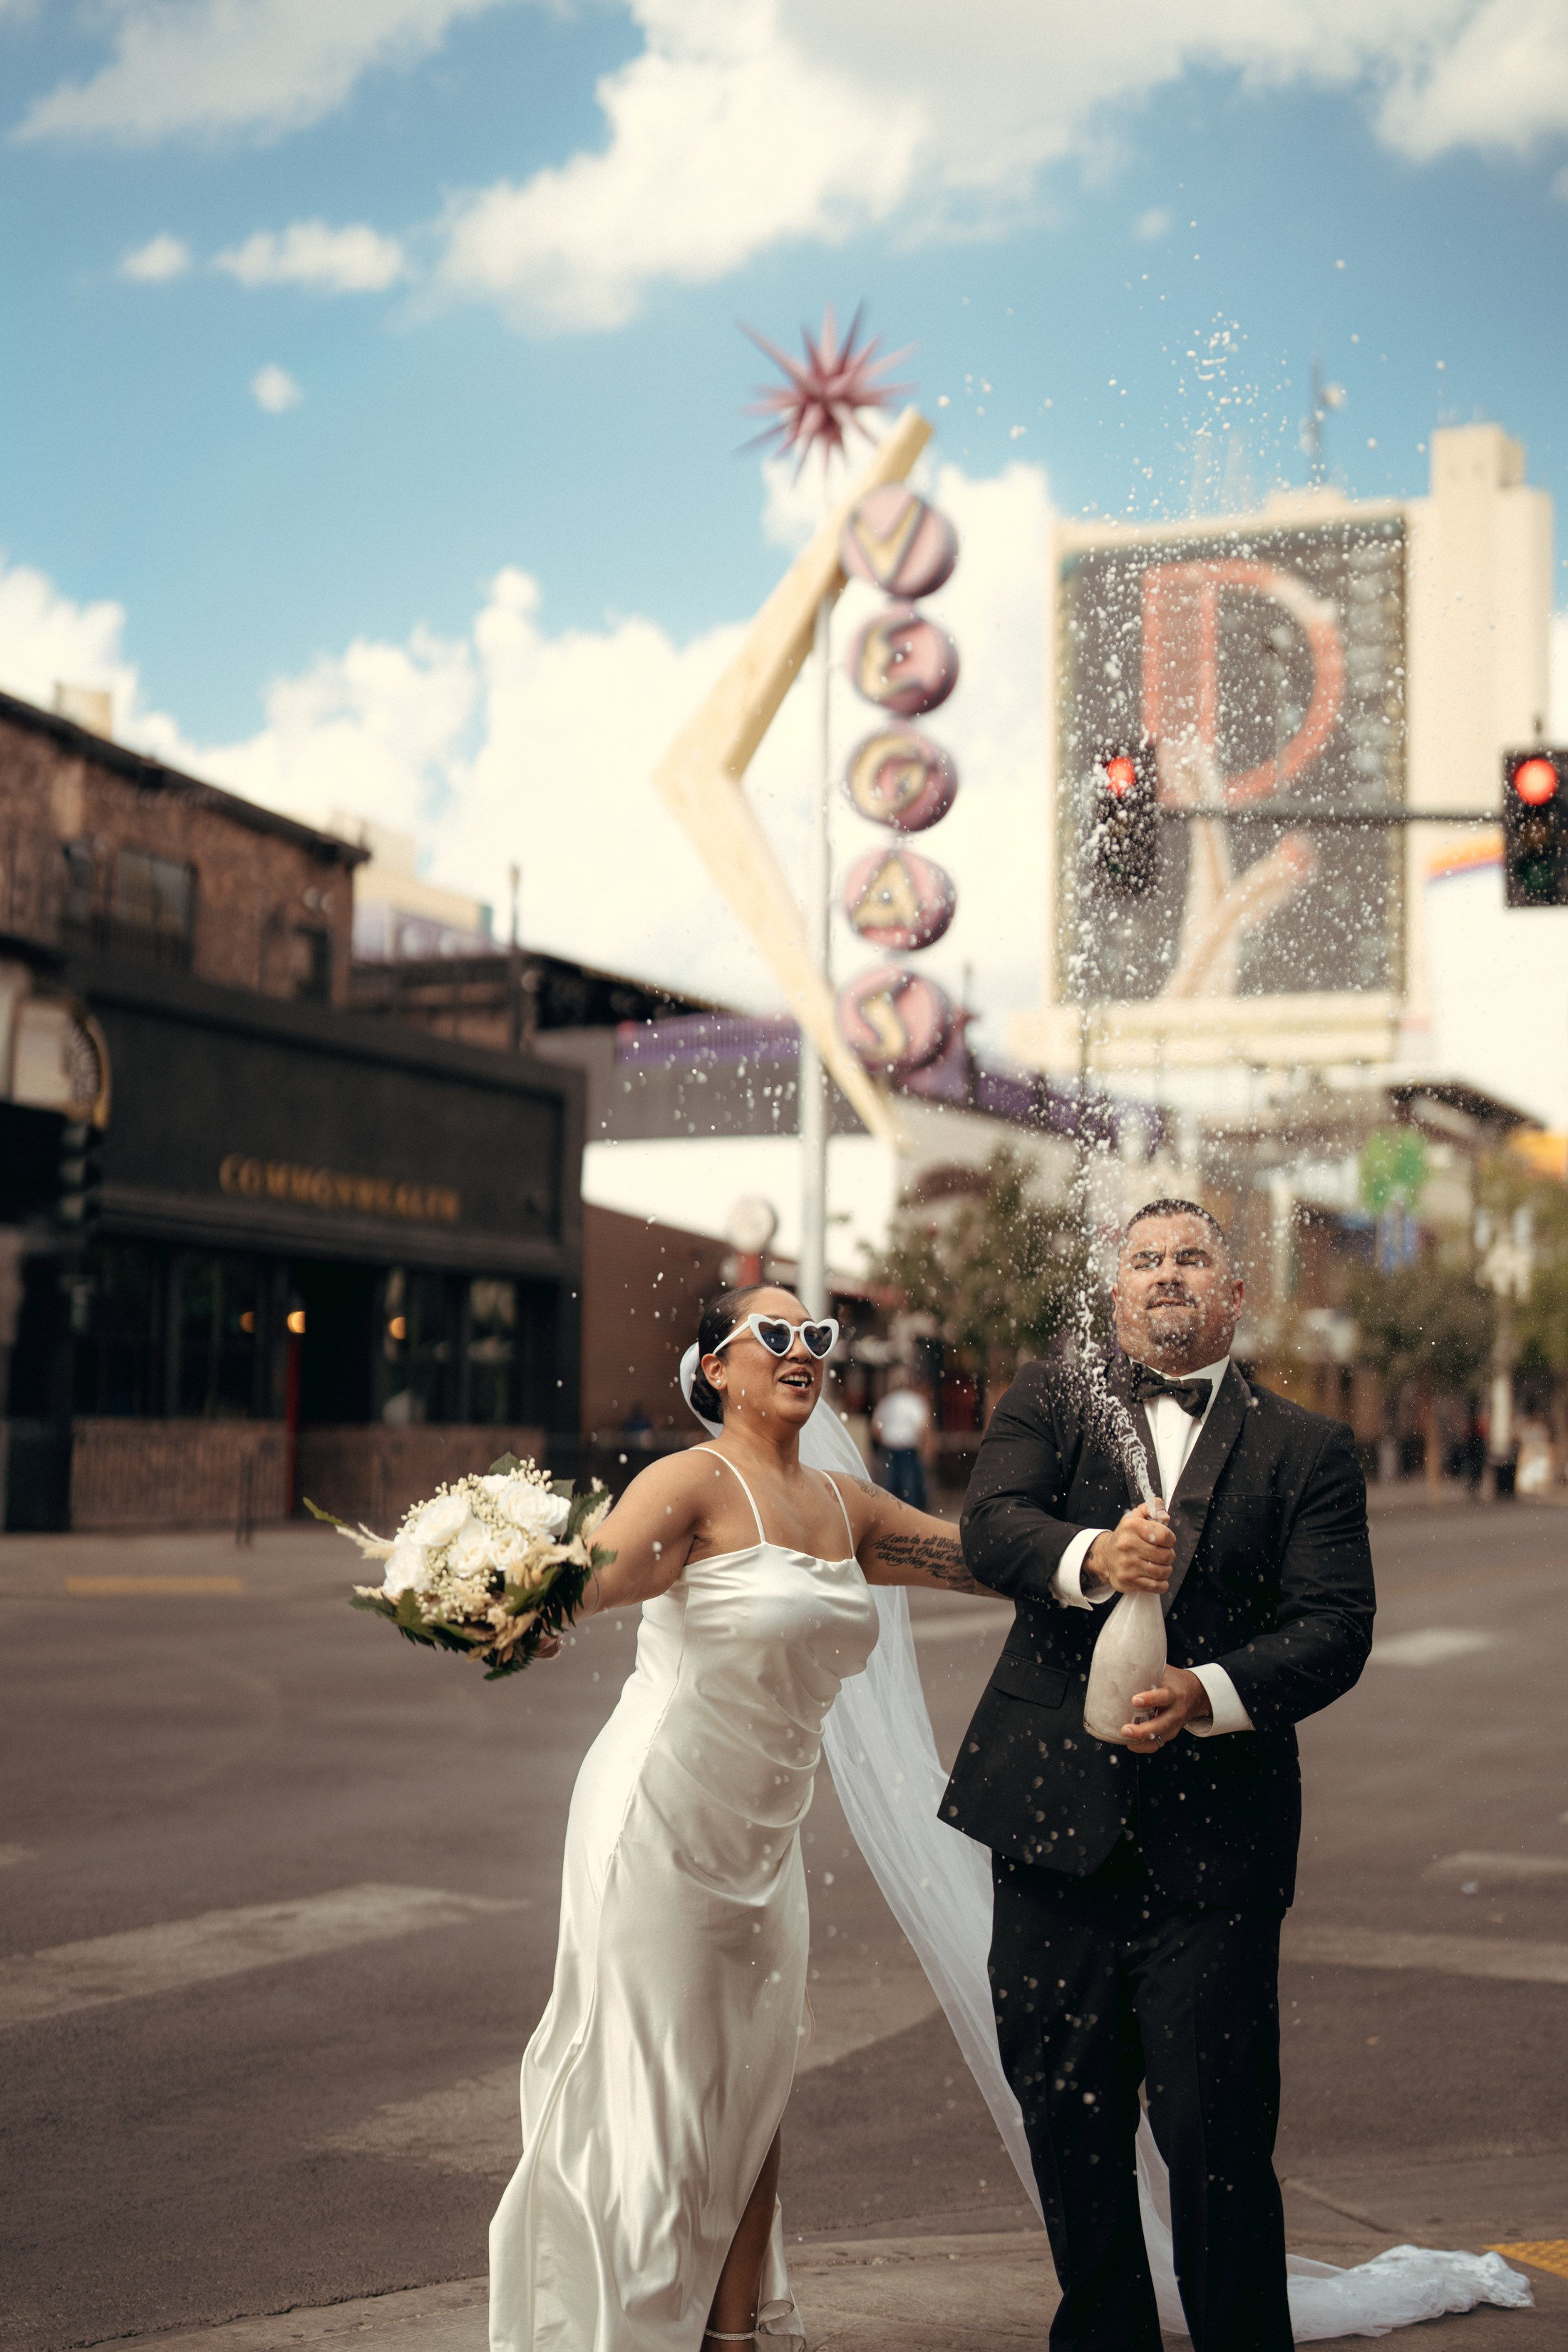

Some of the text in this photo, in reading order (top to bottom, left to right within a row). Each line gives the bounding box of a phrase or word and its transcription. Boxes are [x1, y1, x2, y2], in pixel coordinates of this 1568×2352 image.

[848, 490, 937, 1066] VEGAS
[891, 1535, 909, 1544] can
[910, 1534, 919, 1544] do
[923, 1535, 938, 1545] all
